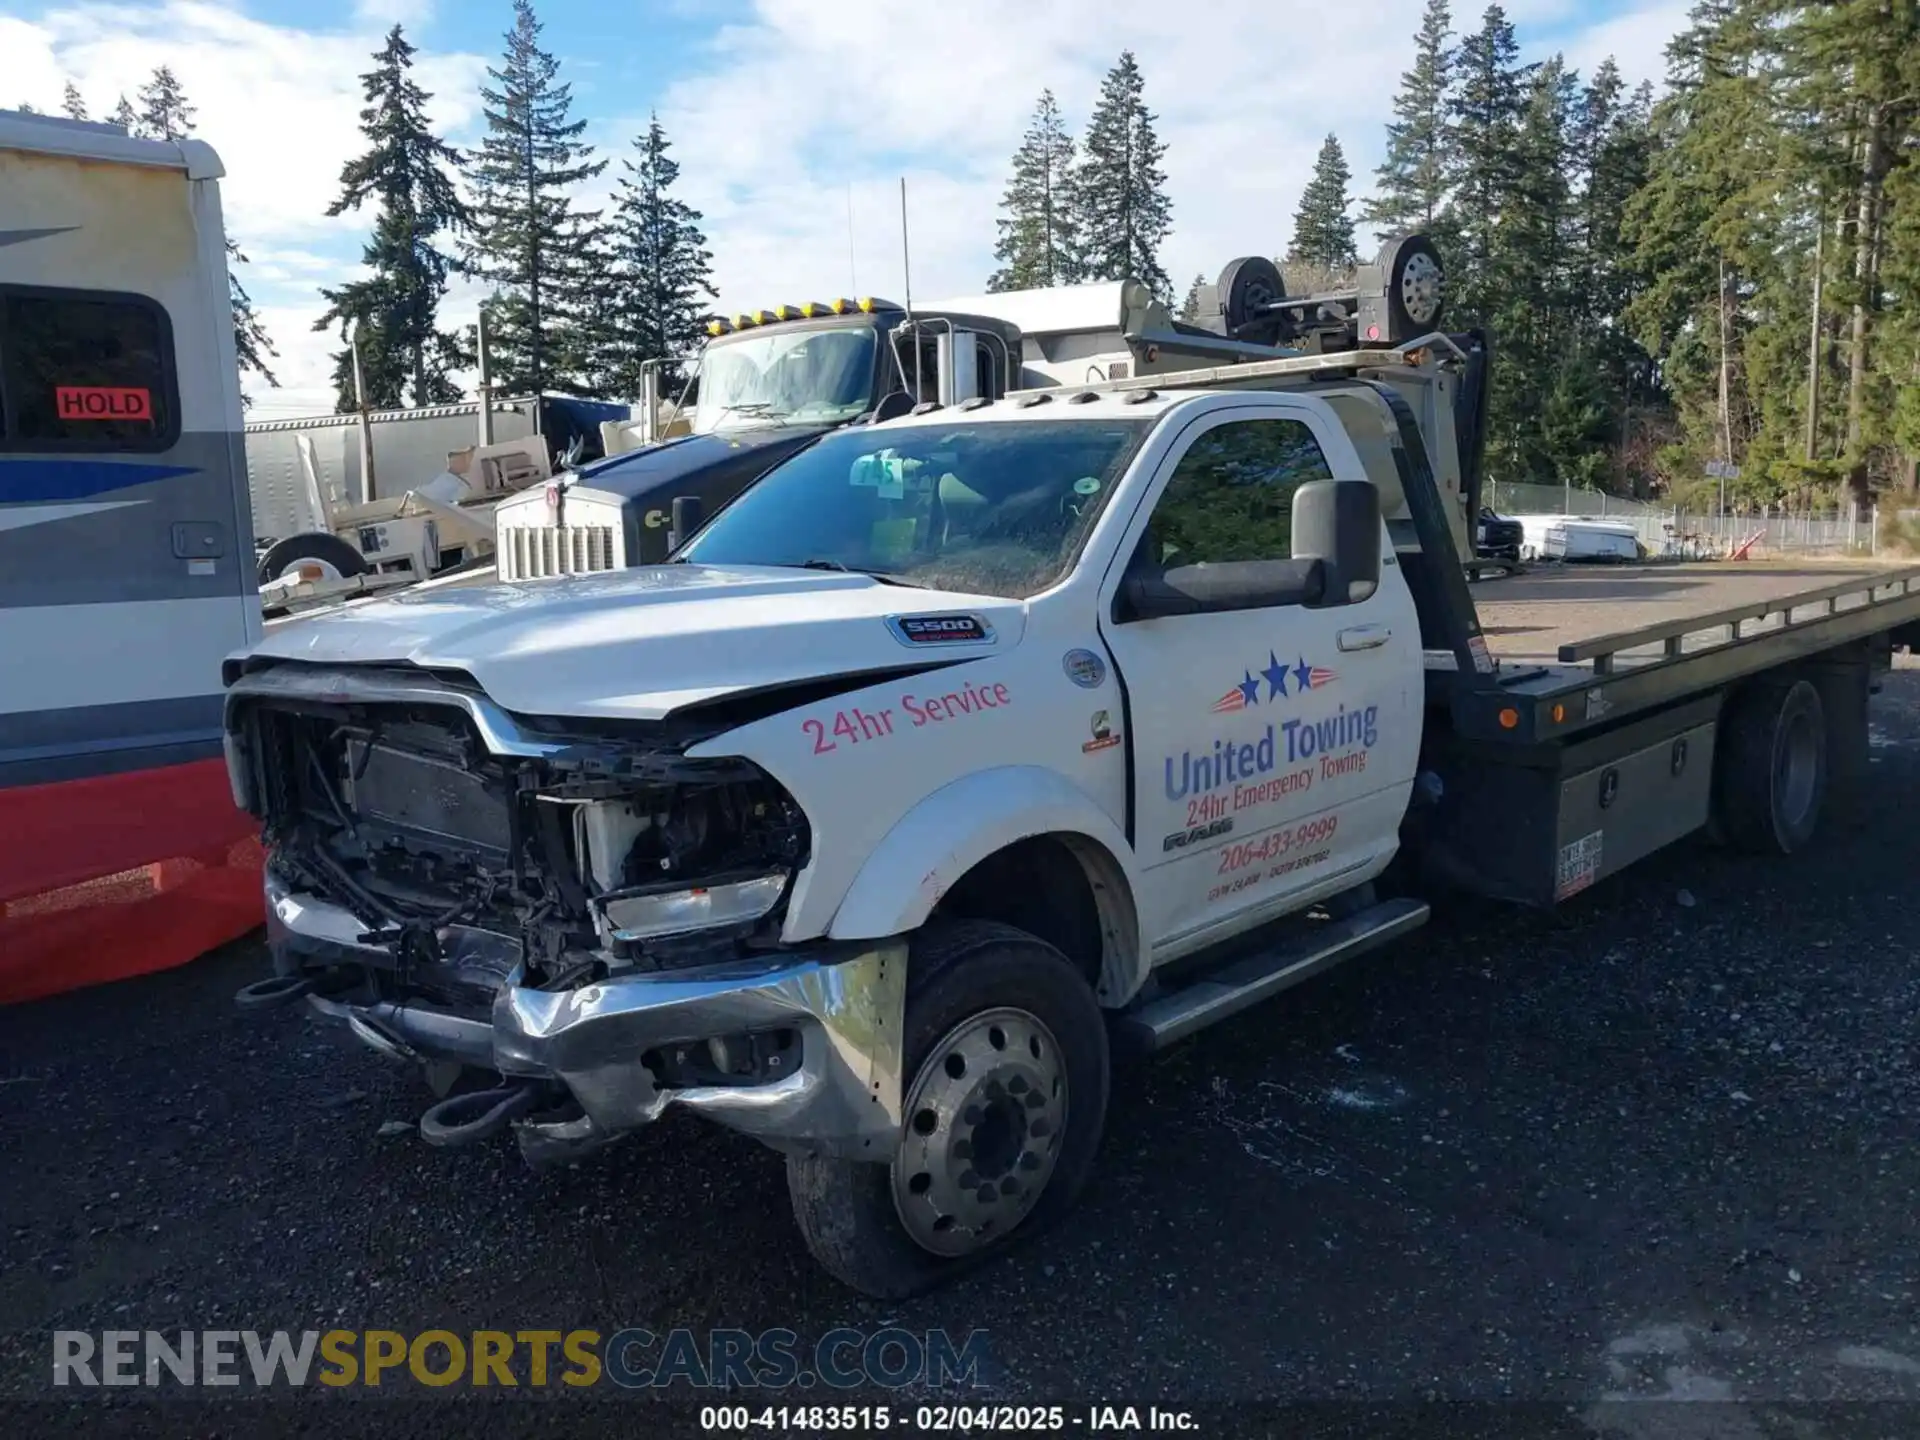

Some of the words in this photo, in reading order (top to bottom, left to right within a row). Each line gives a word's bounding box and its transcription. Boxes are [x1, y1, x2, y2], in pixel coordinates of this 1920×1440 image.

[64, 393, 143, 414] HOLD
[906, 620, 974, 632] 5500
[802, 705, 894, 755] 24hr
[901, 682, 1012, 727] Service
[1165, 726, 1274, 800] United
[1281, 705, 1377, 761] Towing
[1185, 794, 1231, 828] 24hr
[1234, 768, 1314, 810] Emergency
[1318, 750, 1368, 783] Towing
[1218, 816, 1337, 875] 206-433-9999
